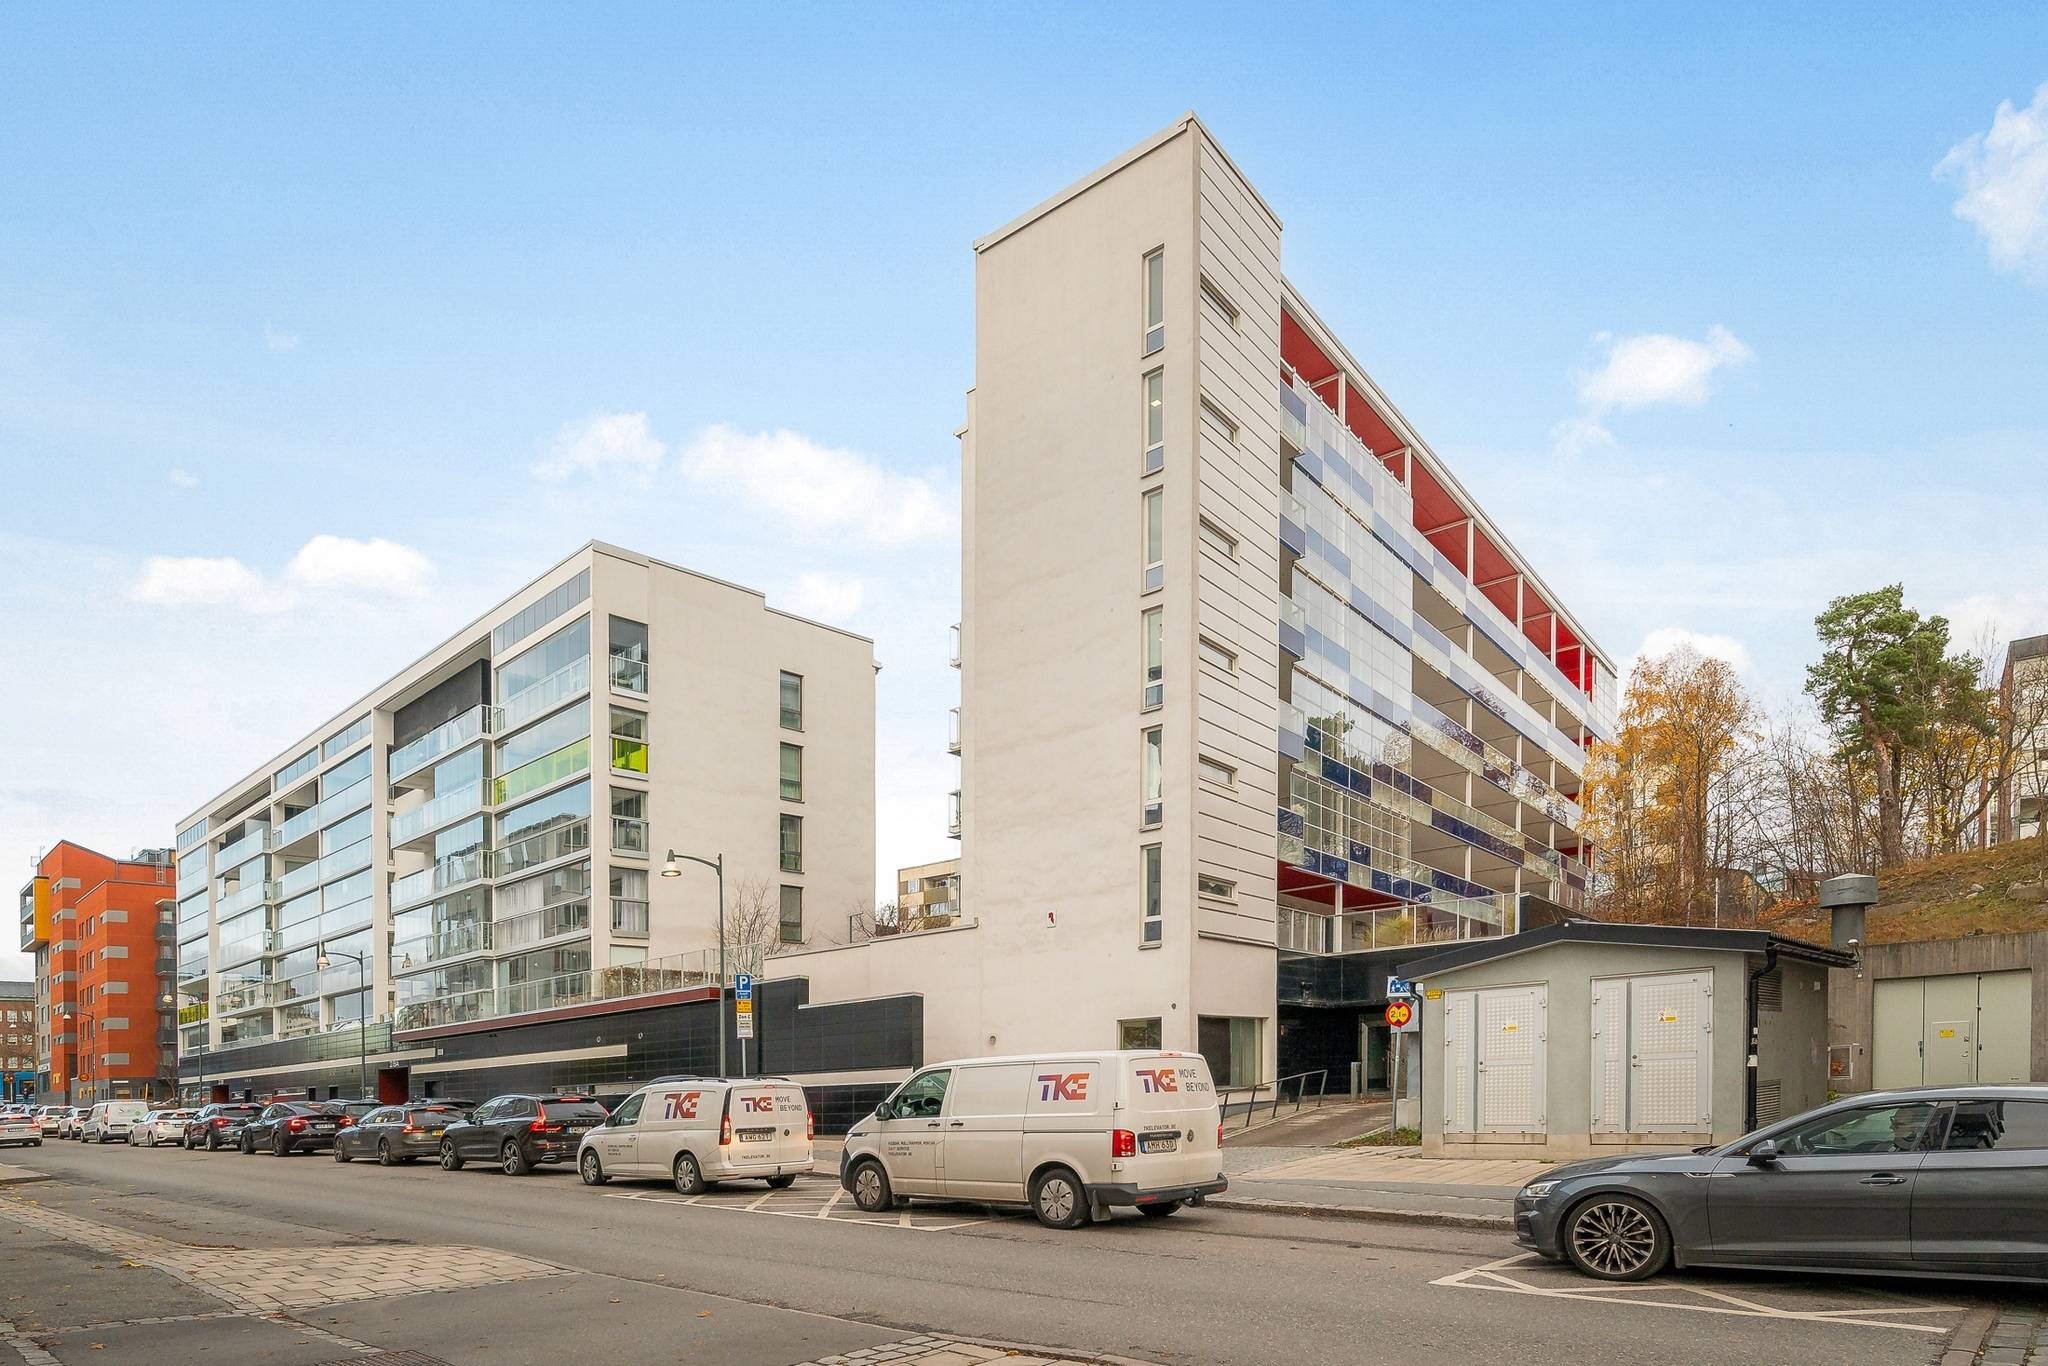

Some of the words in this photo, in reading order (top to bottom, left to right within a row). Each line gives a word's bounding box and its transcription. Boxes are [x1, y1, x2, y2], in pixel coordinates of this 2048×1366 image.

[739, 976, 749, 990] P
[1037, 1073, 1090, 1101] TKE
[1135, 1069, 1178, 1093] TKE
[1178, 1068, 1198, 1078] MOVE
[1185, 1082, 1210, 1092] BEYOND
[664, 1092, 702, 1119] TKE
[740, 1096, 773, 1112] TKE
[774, 1095, 792, 1103] MOVE
[779, 1104, 802, 1112] BEYOND
